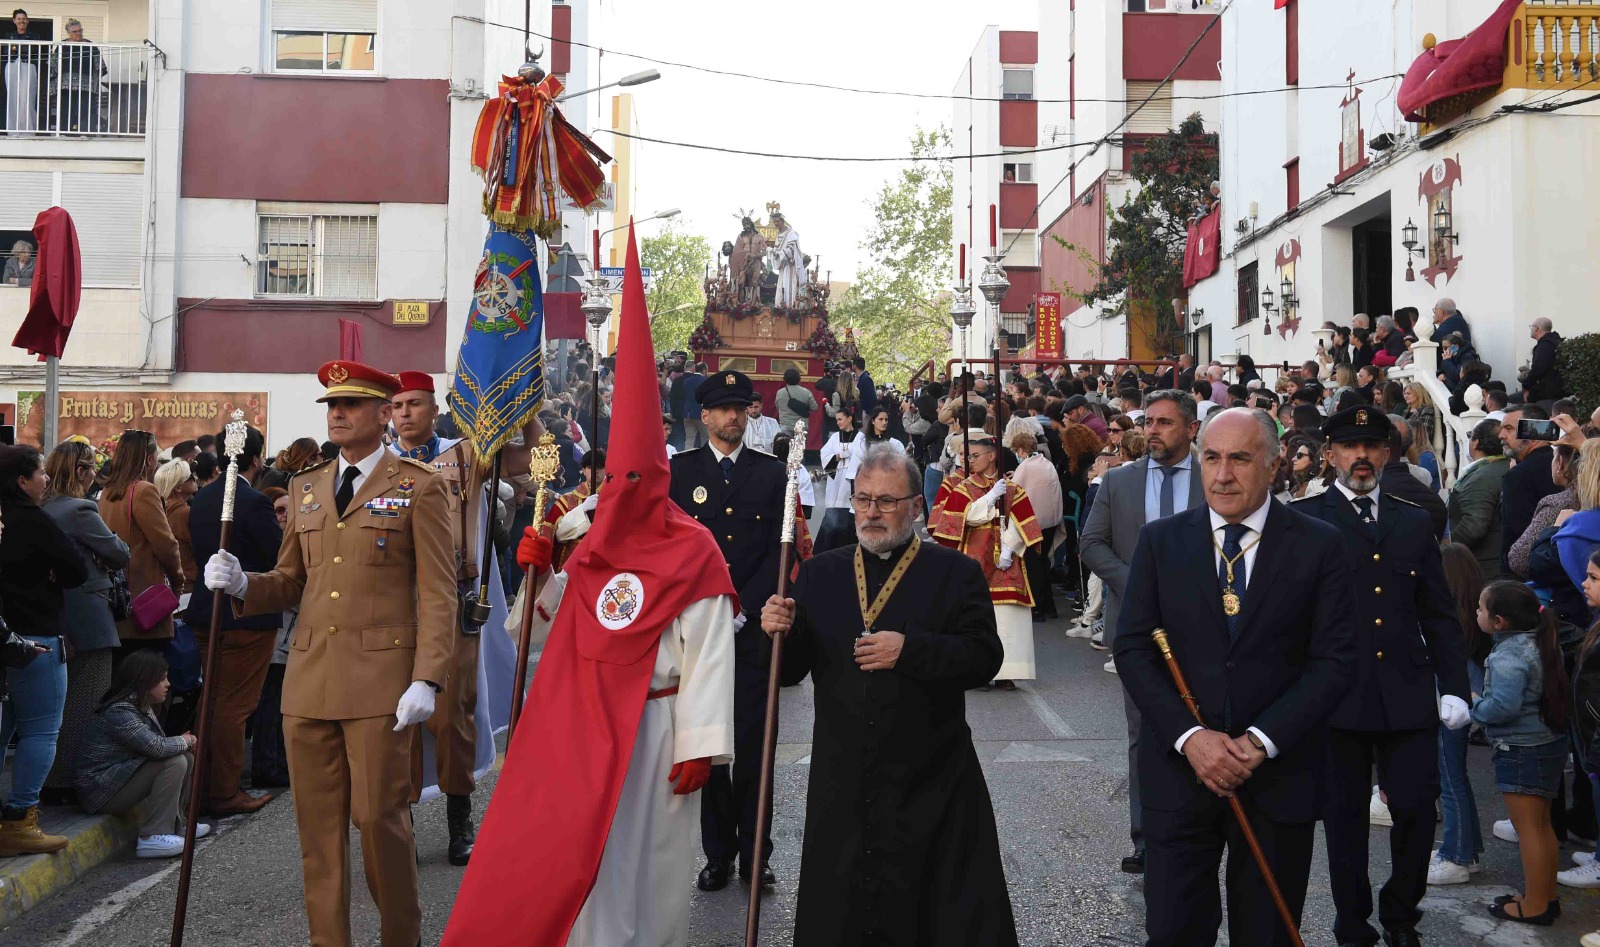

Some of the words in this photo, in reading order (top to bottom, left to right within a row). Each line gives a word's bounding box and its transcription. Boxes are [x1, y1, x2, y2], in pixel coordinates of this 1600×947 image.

[510, 230, 538, 257] CEUT
[599, 268, 649, 276] LIMENN
[497, 301, 512, 315] 54
[1049, 307, 1057, 350] LUMINOSOS
[59, 396, 119, 420] Frutas
[120, 401, 135, 423] y
[140, 395, 219, 419] Verduras
